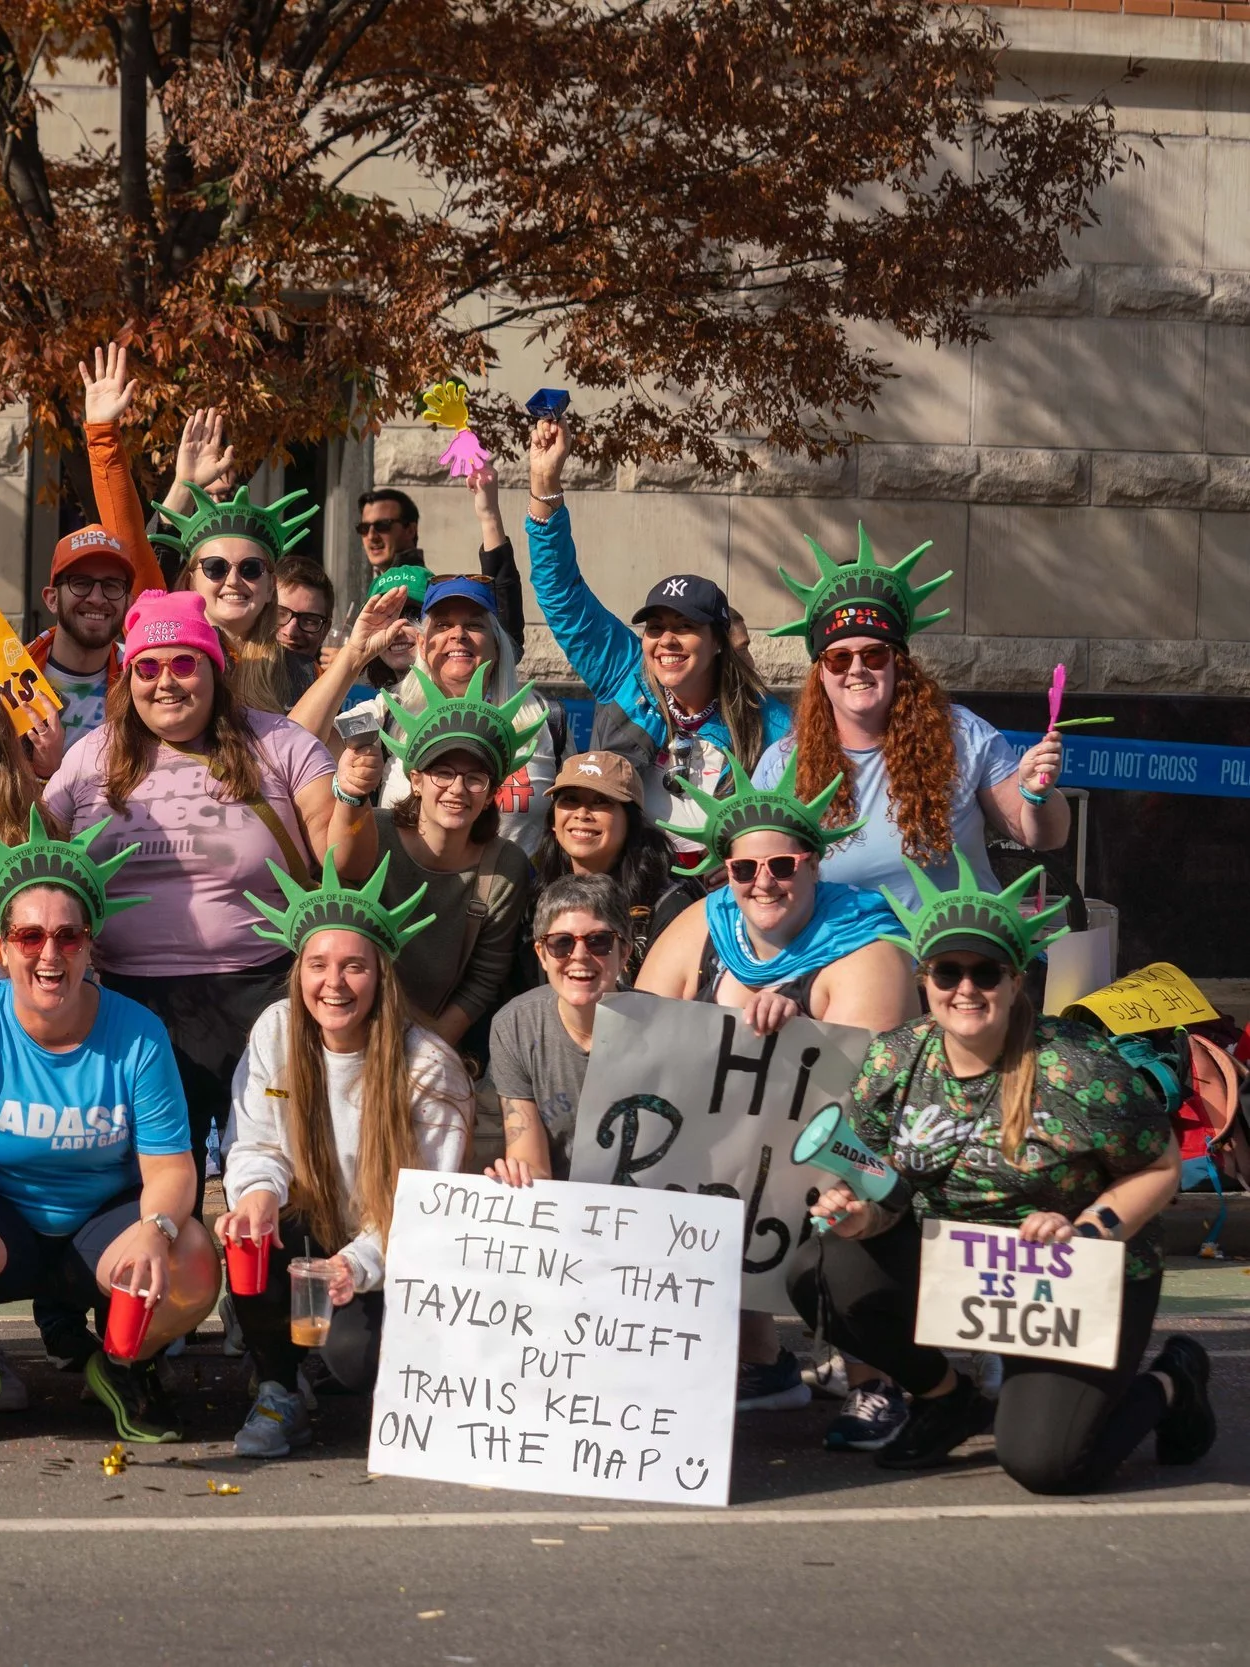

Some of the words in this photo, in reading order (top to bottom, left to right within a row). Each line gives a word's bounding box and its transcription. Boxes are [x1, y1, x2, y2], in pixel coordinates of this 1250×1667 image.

[72, 531, 106, 543] KUDO
[378, 573, 416, 587] Books
[662, 579, 688, 597] NY
[831, 570, 858, 584] STATUE
[835, 608, 878, 619] BADASS
[144, 621, 182, 632] BADASS
[147, 634, 177, 643] GANG
[149, 628, 175, 636] LADY
[436, 703, 467, 716] STATUE
[478, 705, 508, 725] LIBERTY
[1088, 750, 1109, 776] DO
[1114, 752, 1145, 780] NOT
[1150, 754, 1198, 783] CROSS
[716, 800, 742, 819] STATUE
[742, 796, 754, 805] OF
[754, 795, 790, 805] LIBERTY
[4, 848, 33, 868] STATUE
[47, 846, 82, 860] LIBERTY
[298, 895, 324, 911] STATUE
[338, 894, 374, 910] LIBERTY
[1152, 986, 1206, 1015] THE
[708, 1014, 821, 1122] Hi
[51, 1136, 96, 1150] LADY
[830, 1140, 885, 1172] BADASS
[965, 1145, 1044, 1169] CLB
[420, 1182, 560, 1233] SMILE
[581, 1205, 639, 1240] IF
[667, 1214, 720, 1256] YOU
[950, 1230, 1075, 1279] THIS
[454, 1232, 584, 1286] THINK
[610, 1265, 715, 1307] THAT
[979, 1272, 1016, 1298] IS
[1033, 1279, 1054, 1303] A
[395, 1278, 533, 1337] TAYLOR
[564, 1312, 701, 1360] SWIFT
[956, 1295, 1081, 1348] SIGN
[521, 1345, 586, 1379] PUT
[399, 1365, 517, 1414] TRAVIS
[545, 1388, 678, 1435] KELCE
[378, 1411, 433, 1452] ON
[457, 1422, 549, 1465] THE
[573, 1437, 661, 1482] MAP
